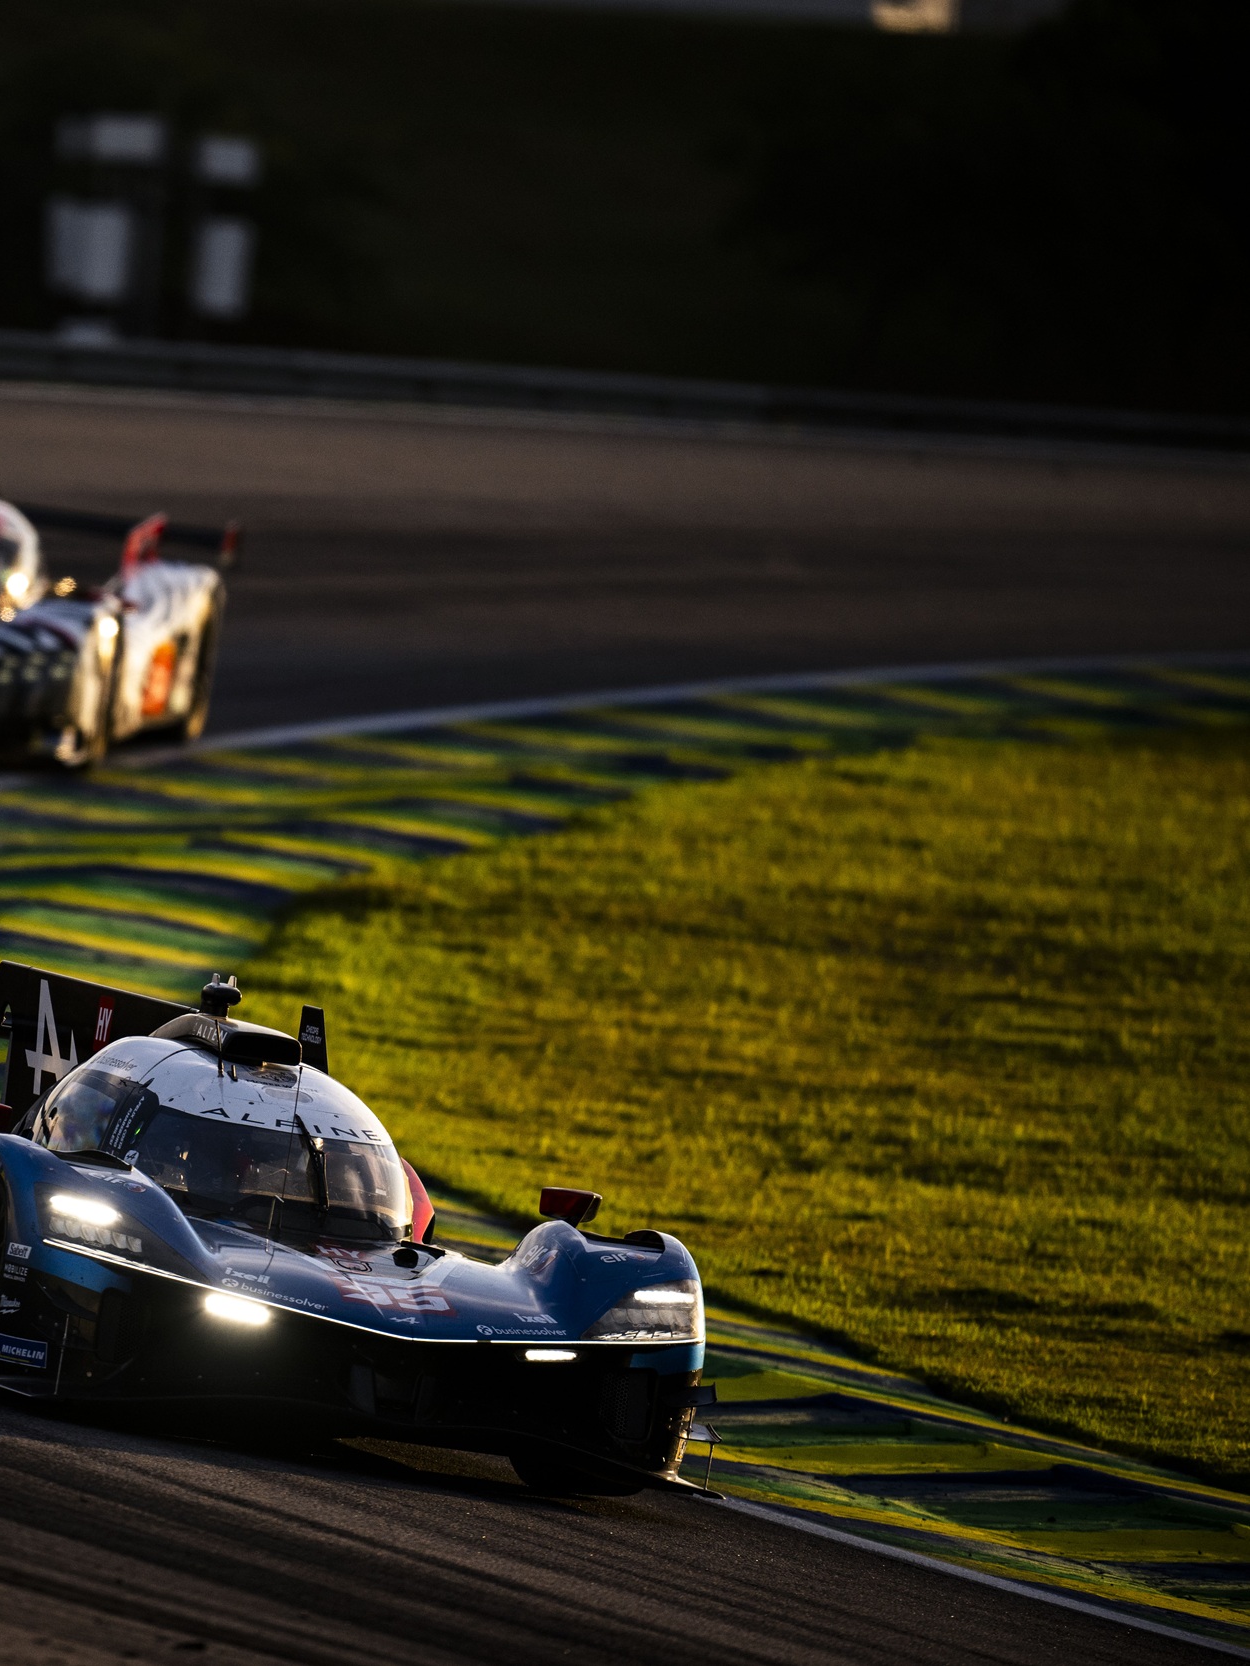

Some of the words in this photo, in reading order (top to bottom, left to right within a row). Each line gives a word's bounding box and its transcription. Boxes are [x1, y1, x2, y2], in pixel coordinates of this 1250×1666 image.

[95, 1006, 113, 1042] HY
[196, 1023, 228, 1044] ALTEN
[200, 1107, 382, 1143] ALPINE
[9, 1243, 29, 1258] Sabelt
[316, 1245, 360, 1259] HY
[601, 1253, 628, 1263] elf
[224, 1267, 270, 1284] ixell
[240, 1282, 327, 1311] businessolver
[493, 1326, 567, 1336] businessolver
[1, 1344, 45, 1360] MICHELIN
